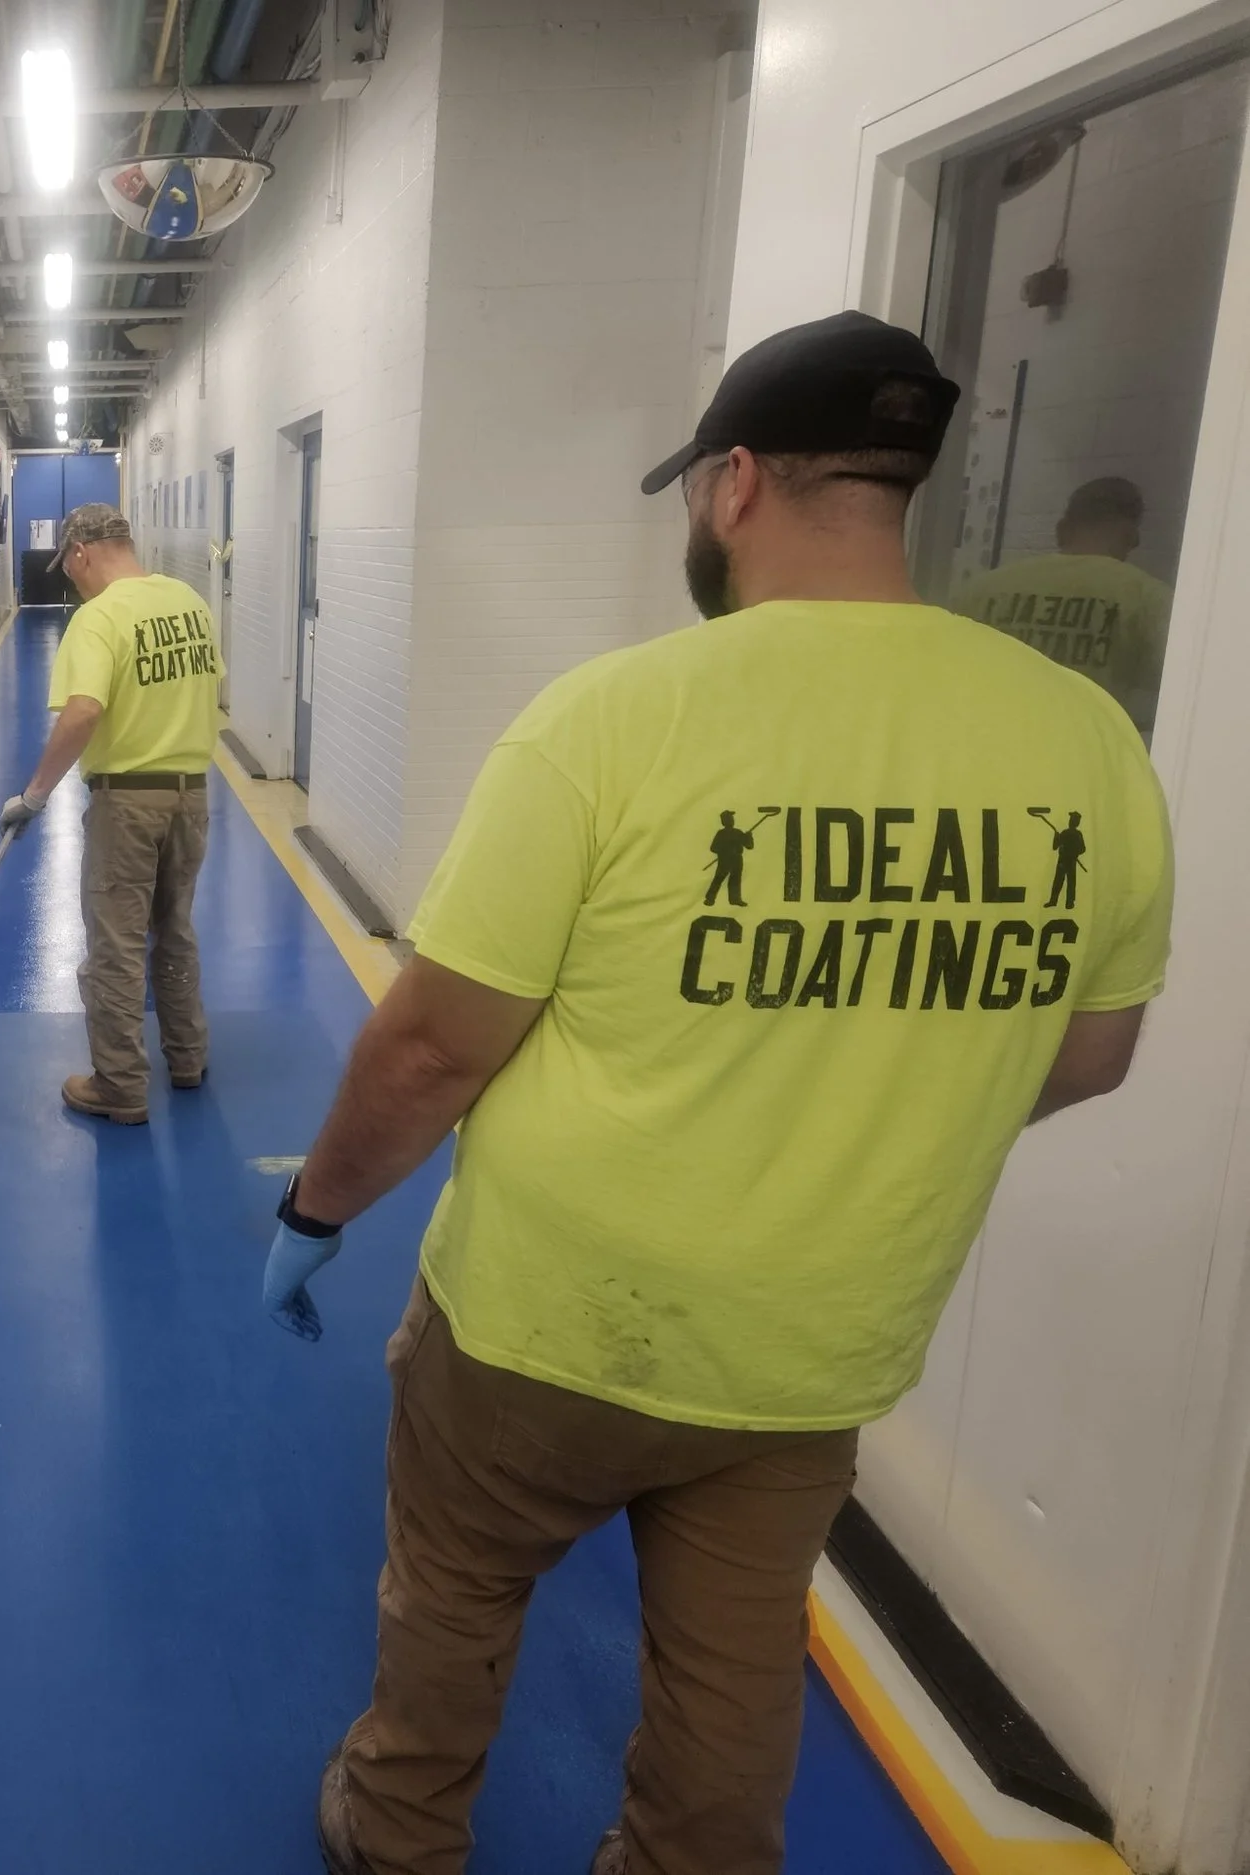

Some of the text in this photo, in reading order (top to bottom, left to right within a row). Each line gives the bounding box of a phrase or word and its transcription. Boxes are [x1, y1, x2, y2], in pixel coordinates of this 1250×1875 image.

[150, 610, 206, 648] IDEAL
[783, 807, 1026, 903] IDEAL
[680, 915, 1079, 1010] COATINGS
